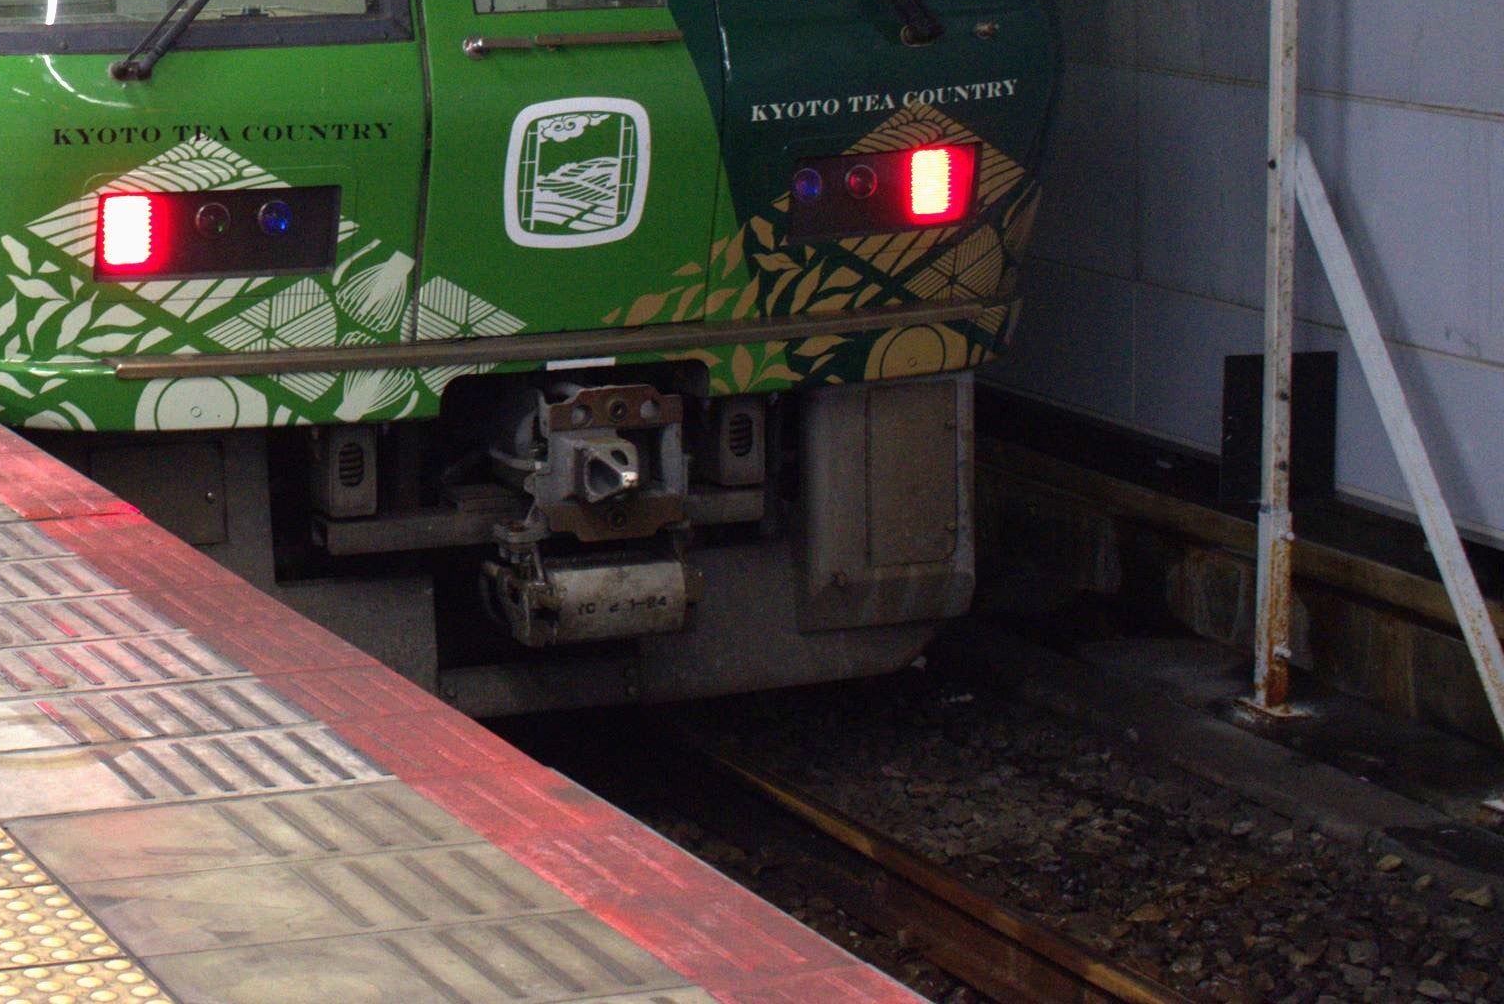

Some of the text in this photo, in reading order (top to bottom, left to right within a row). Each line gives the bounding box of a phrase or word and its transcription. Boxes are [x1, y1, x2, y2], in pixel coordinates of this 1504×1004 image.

[750, 78, 1019, 122] KYOTO TEA COUNTRY
[53, 122, 393, 146] KYOTO TEA COUNTRY
